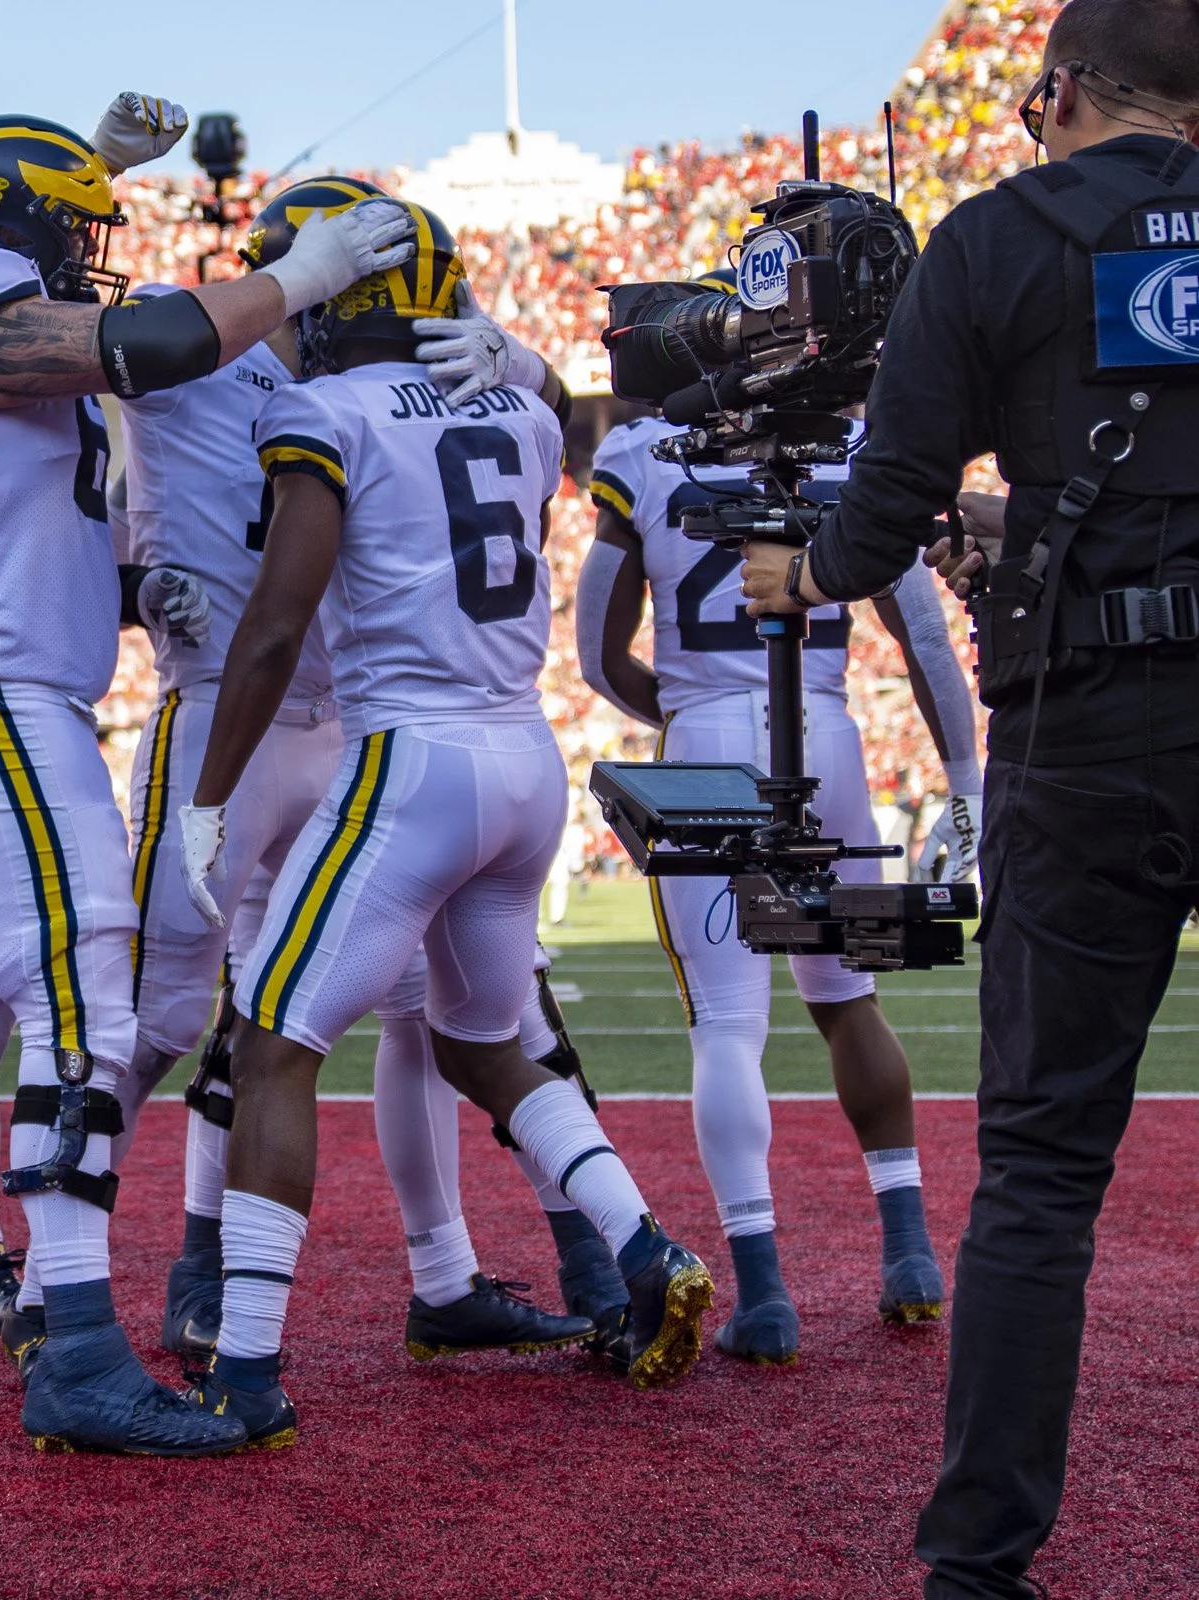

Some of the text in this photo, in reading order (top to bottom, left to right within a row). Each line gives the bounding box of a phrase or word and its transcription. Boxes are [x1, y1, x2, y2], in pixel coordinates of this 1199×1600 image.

[751, 245, 786, 283] FOX
[378, 293, 387, 307] 6
[752, 274, 786, 295] SPORTS
[1171, 275, 1199, 319] F
[388, 382, 530, 420] JOHSON
[434, 425, 538, 625] 6
